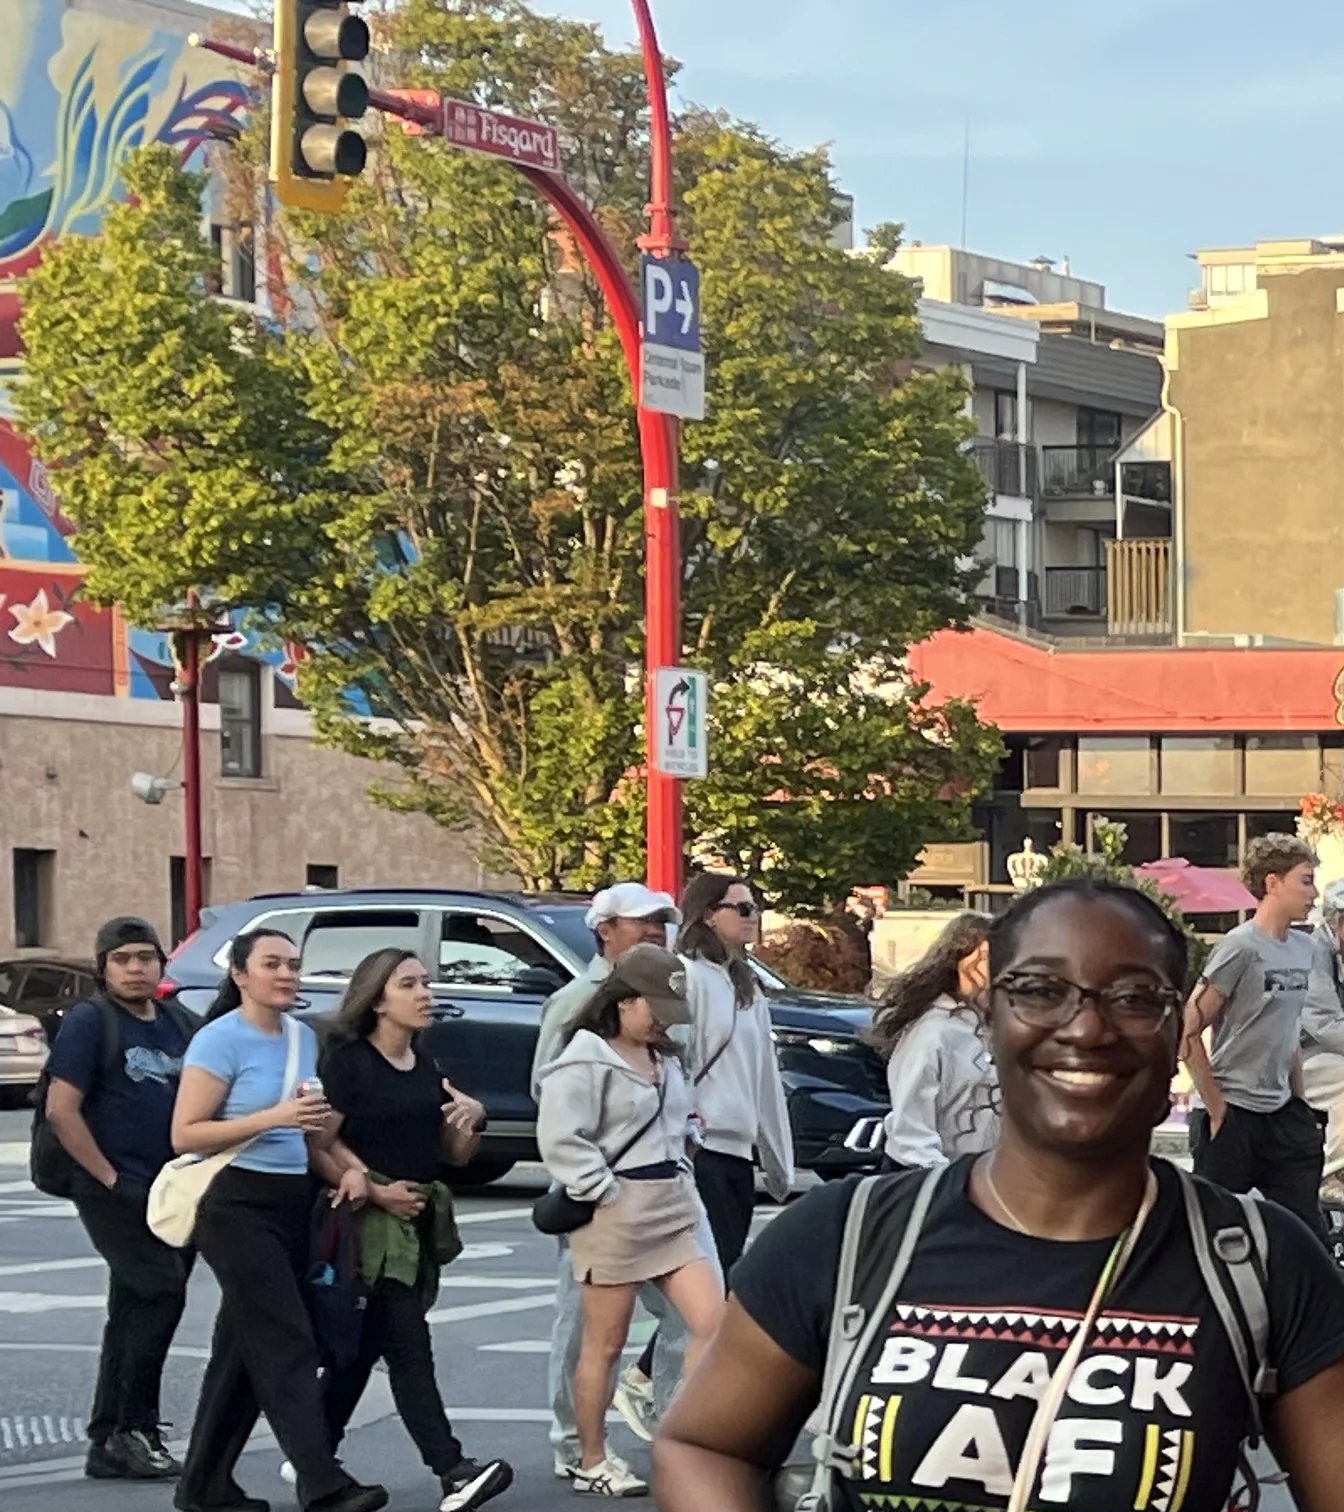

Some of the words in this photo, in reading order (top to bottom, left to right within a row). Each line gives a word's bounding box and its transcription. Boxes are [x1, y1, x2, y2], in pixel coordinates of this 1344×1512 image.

[478, 110, 554, 160] Fisgard
[646, 263, 673, 336] P
[870, 1336, 1193, 1417] BLACK
[911, 1403, 1124, 1504] AF
